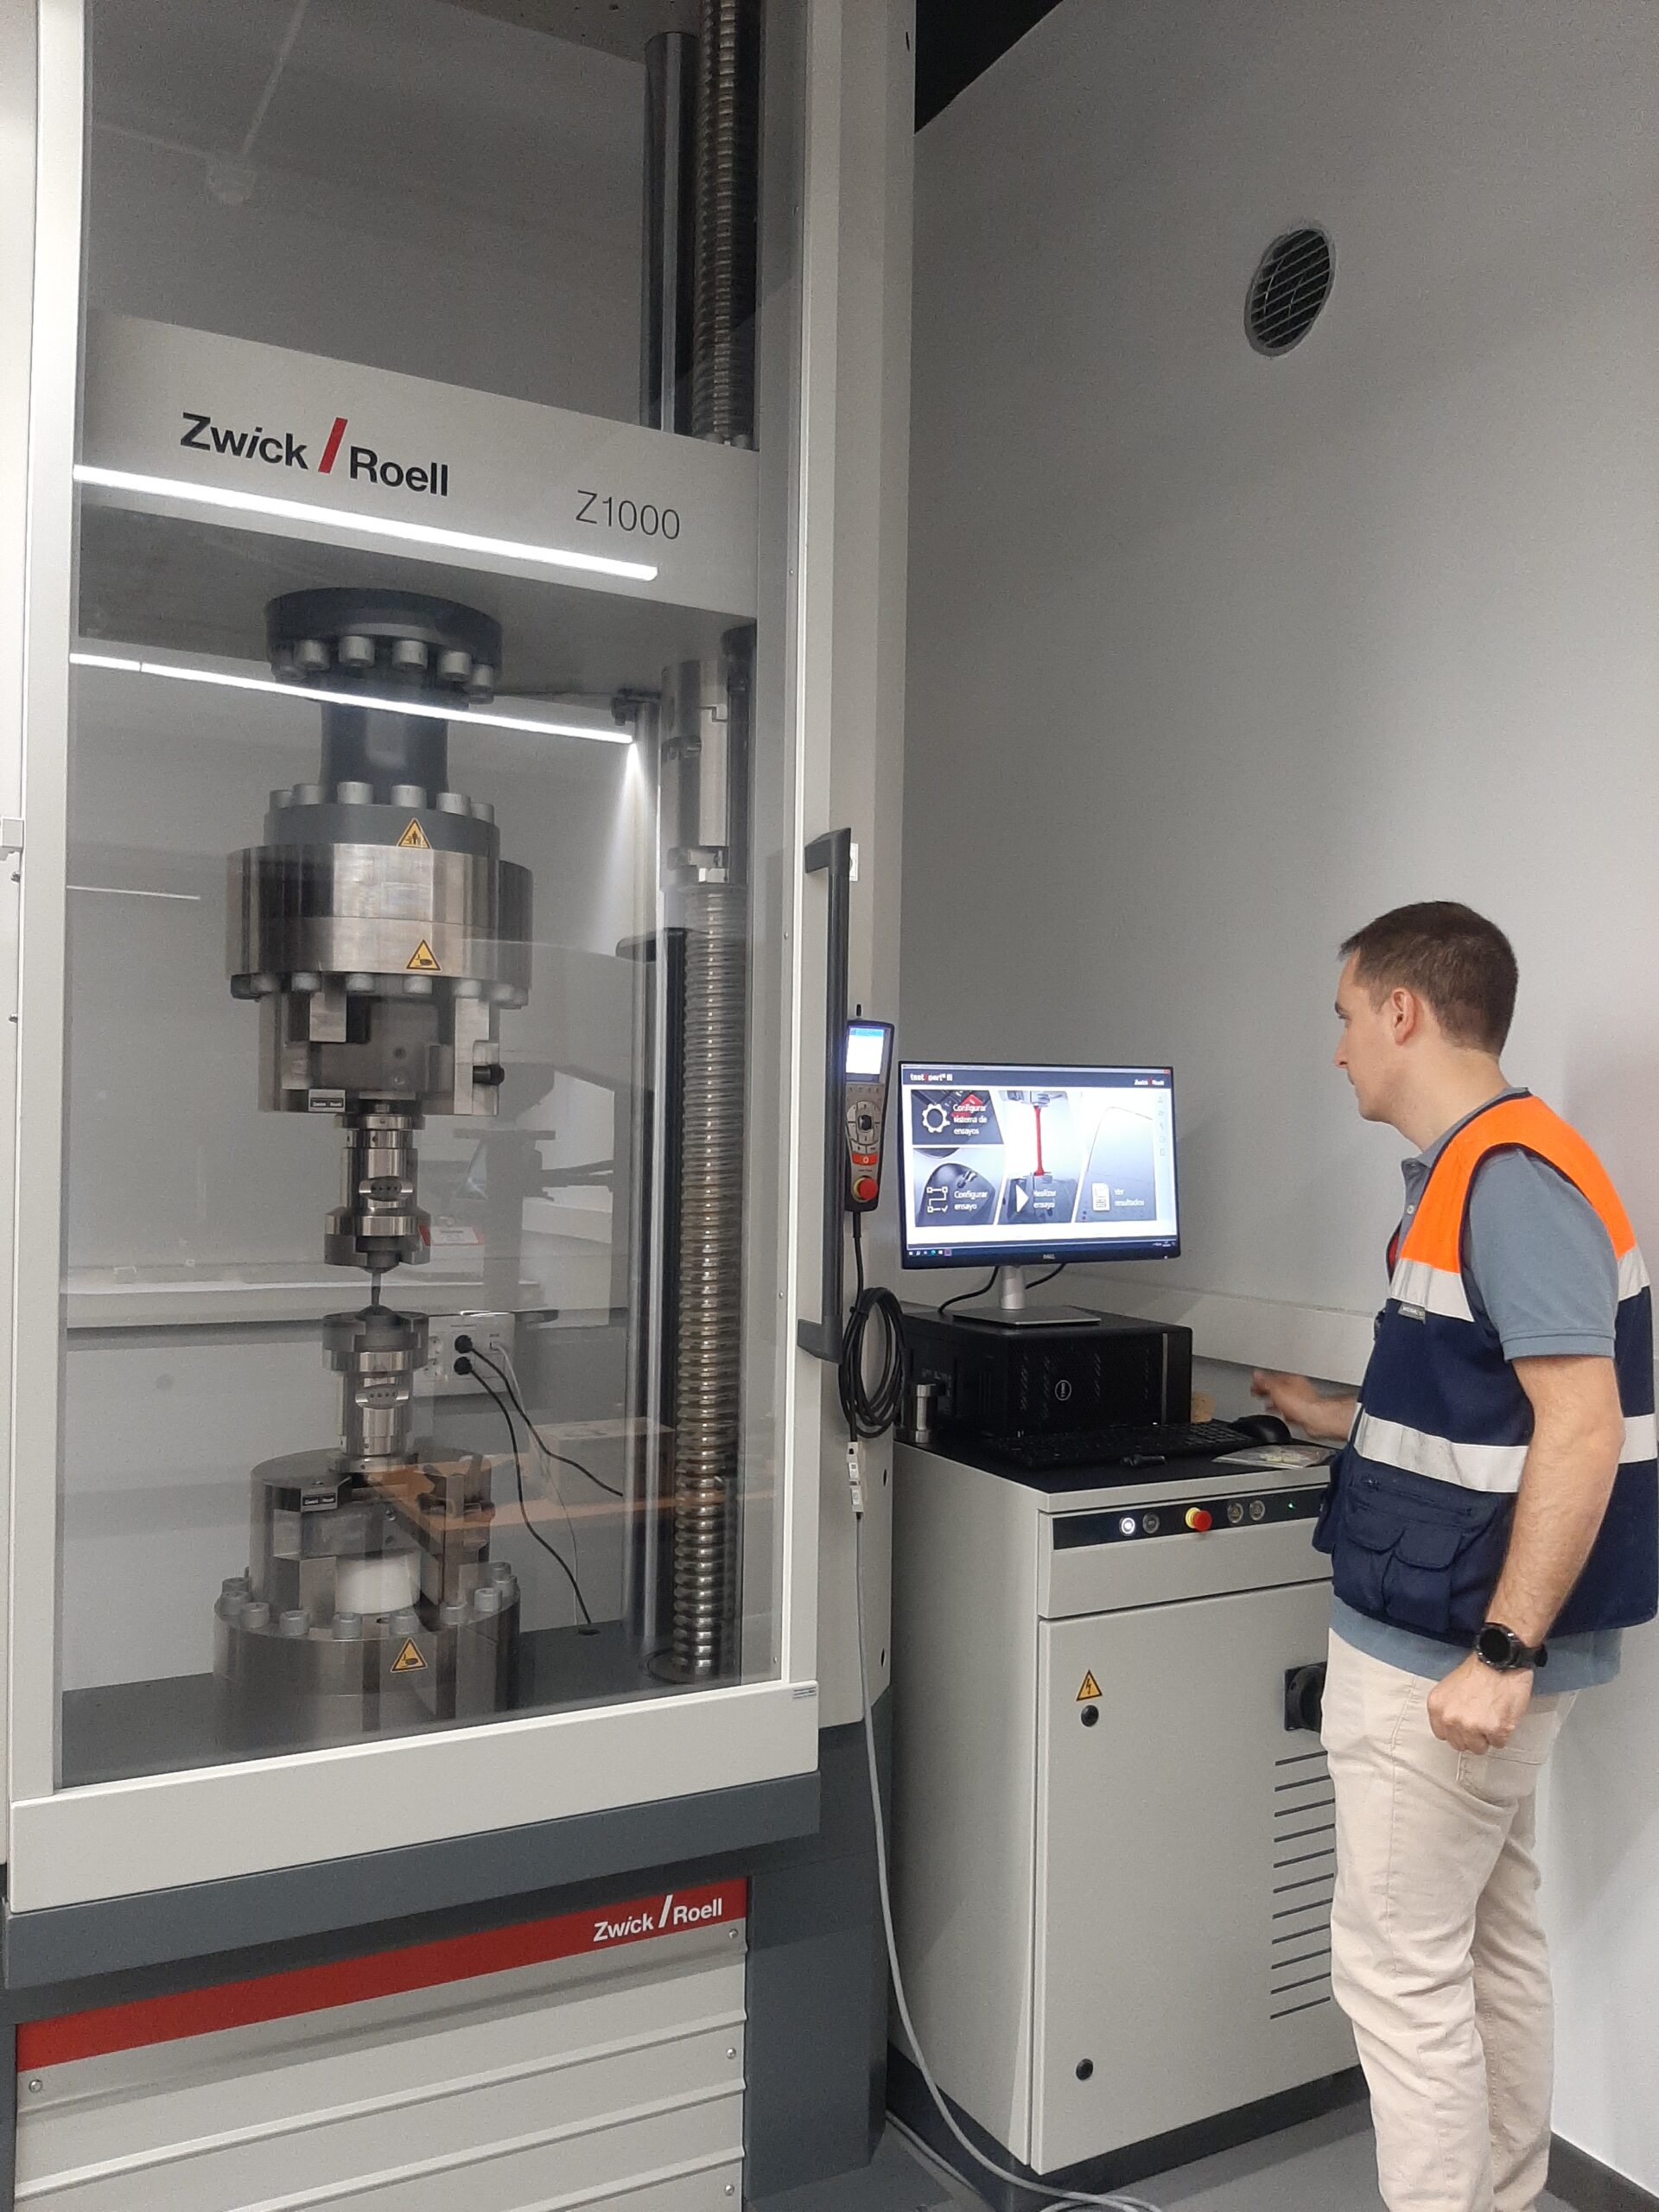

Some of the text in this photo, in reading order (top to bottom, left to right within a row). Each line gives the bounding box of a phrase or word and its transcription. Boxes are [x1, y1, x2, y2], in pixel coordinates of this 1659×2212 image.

[180, 411, 448, 497] Zwick Roell
[575, 489, 681, 540] Z1000
[953, 1128, 980, 1136] ensayos
[954, 1191, 988, 1200] Configurar
[954, 1203, 977, 1211] ensayo
[593, 1897, 722, 1942] Zwick Roell
